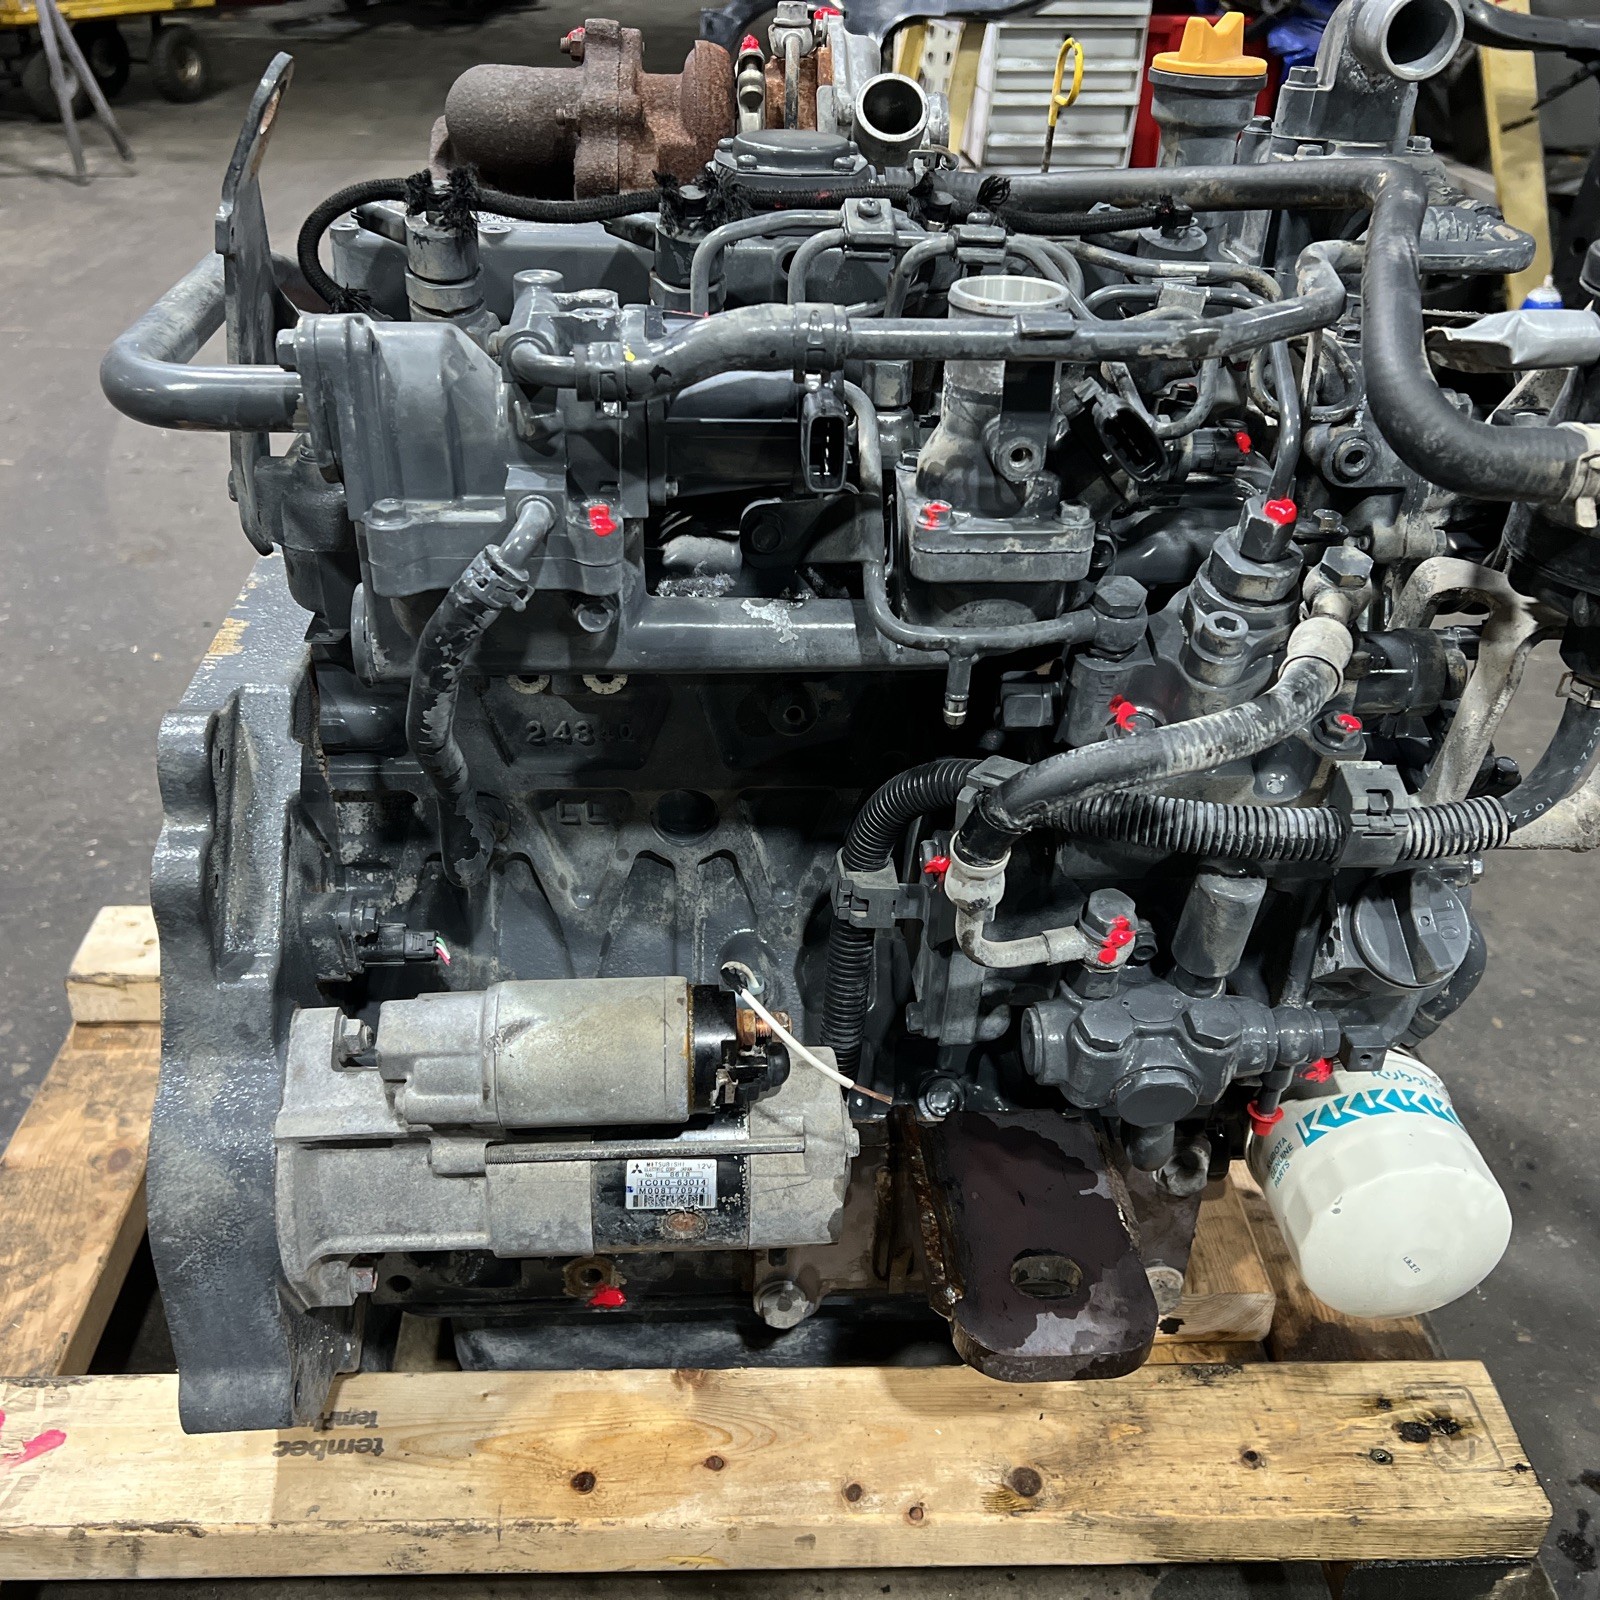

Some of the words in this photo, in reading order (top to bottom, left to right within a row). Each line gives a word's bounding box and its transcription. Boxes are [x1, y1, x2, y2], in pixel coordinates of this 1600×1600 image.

[1270, 1142, 1294, 1180] GENUINE
[1274, 1160, 1291, 1189] PARTS
[273, 1437, 385, 1461] tembec
